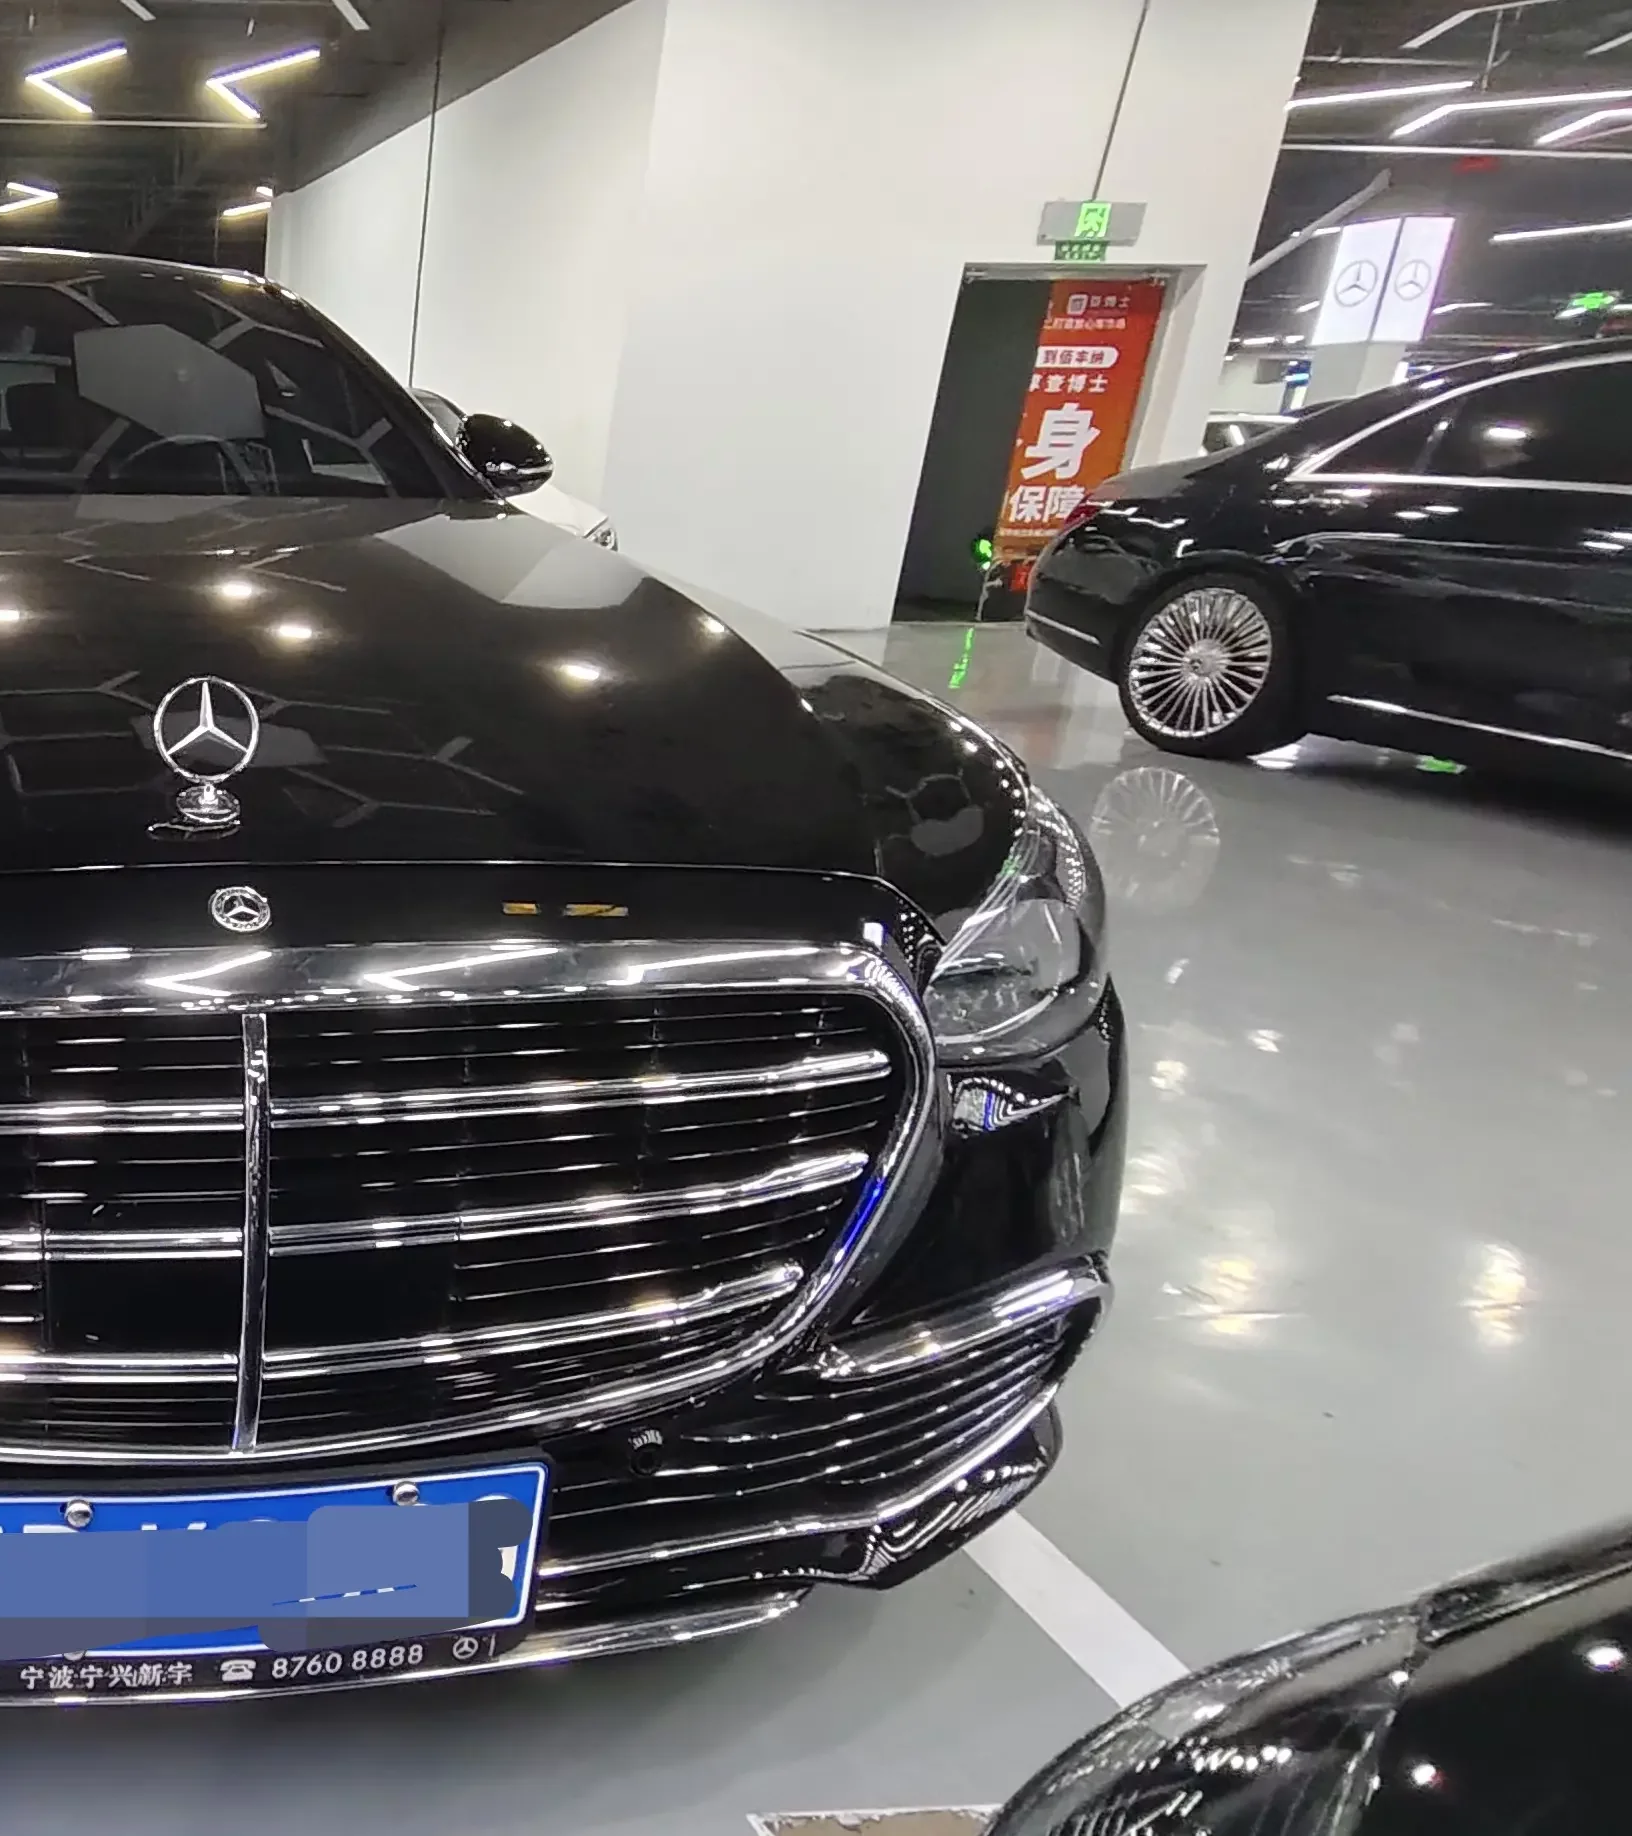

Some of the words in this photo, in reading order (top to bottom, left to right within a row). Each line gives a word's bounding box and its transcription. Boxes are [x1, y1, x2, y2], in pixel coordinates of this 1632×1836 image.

[1016, 402, 1101, 480] 身
[271, 1651, 343, 1680] 8760
[351, 1643, 424, 1671] 8888
